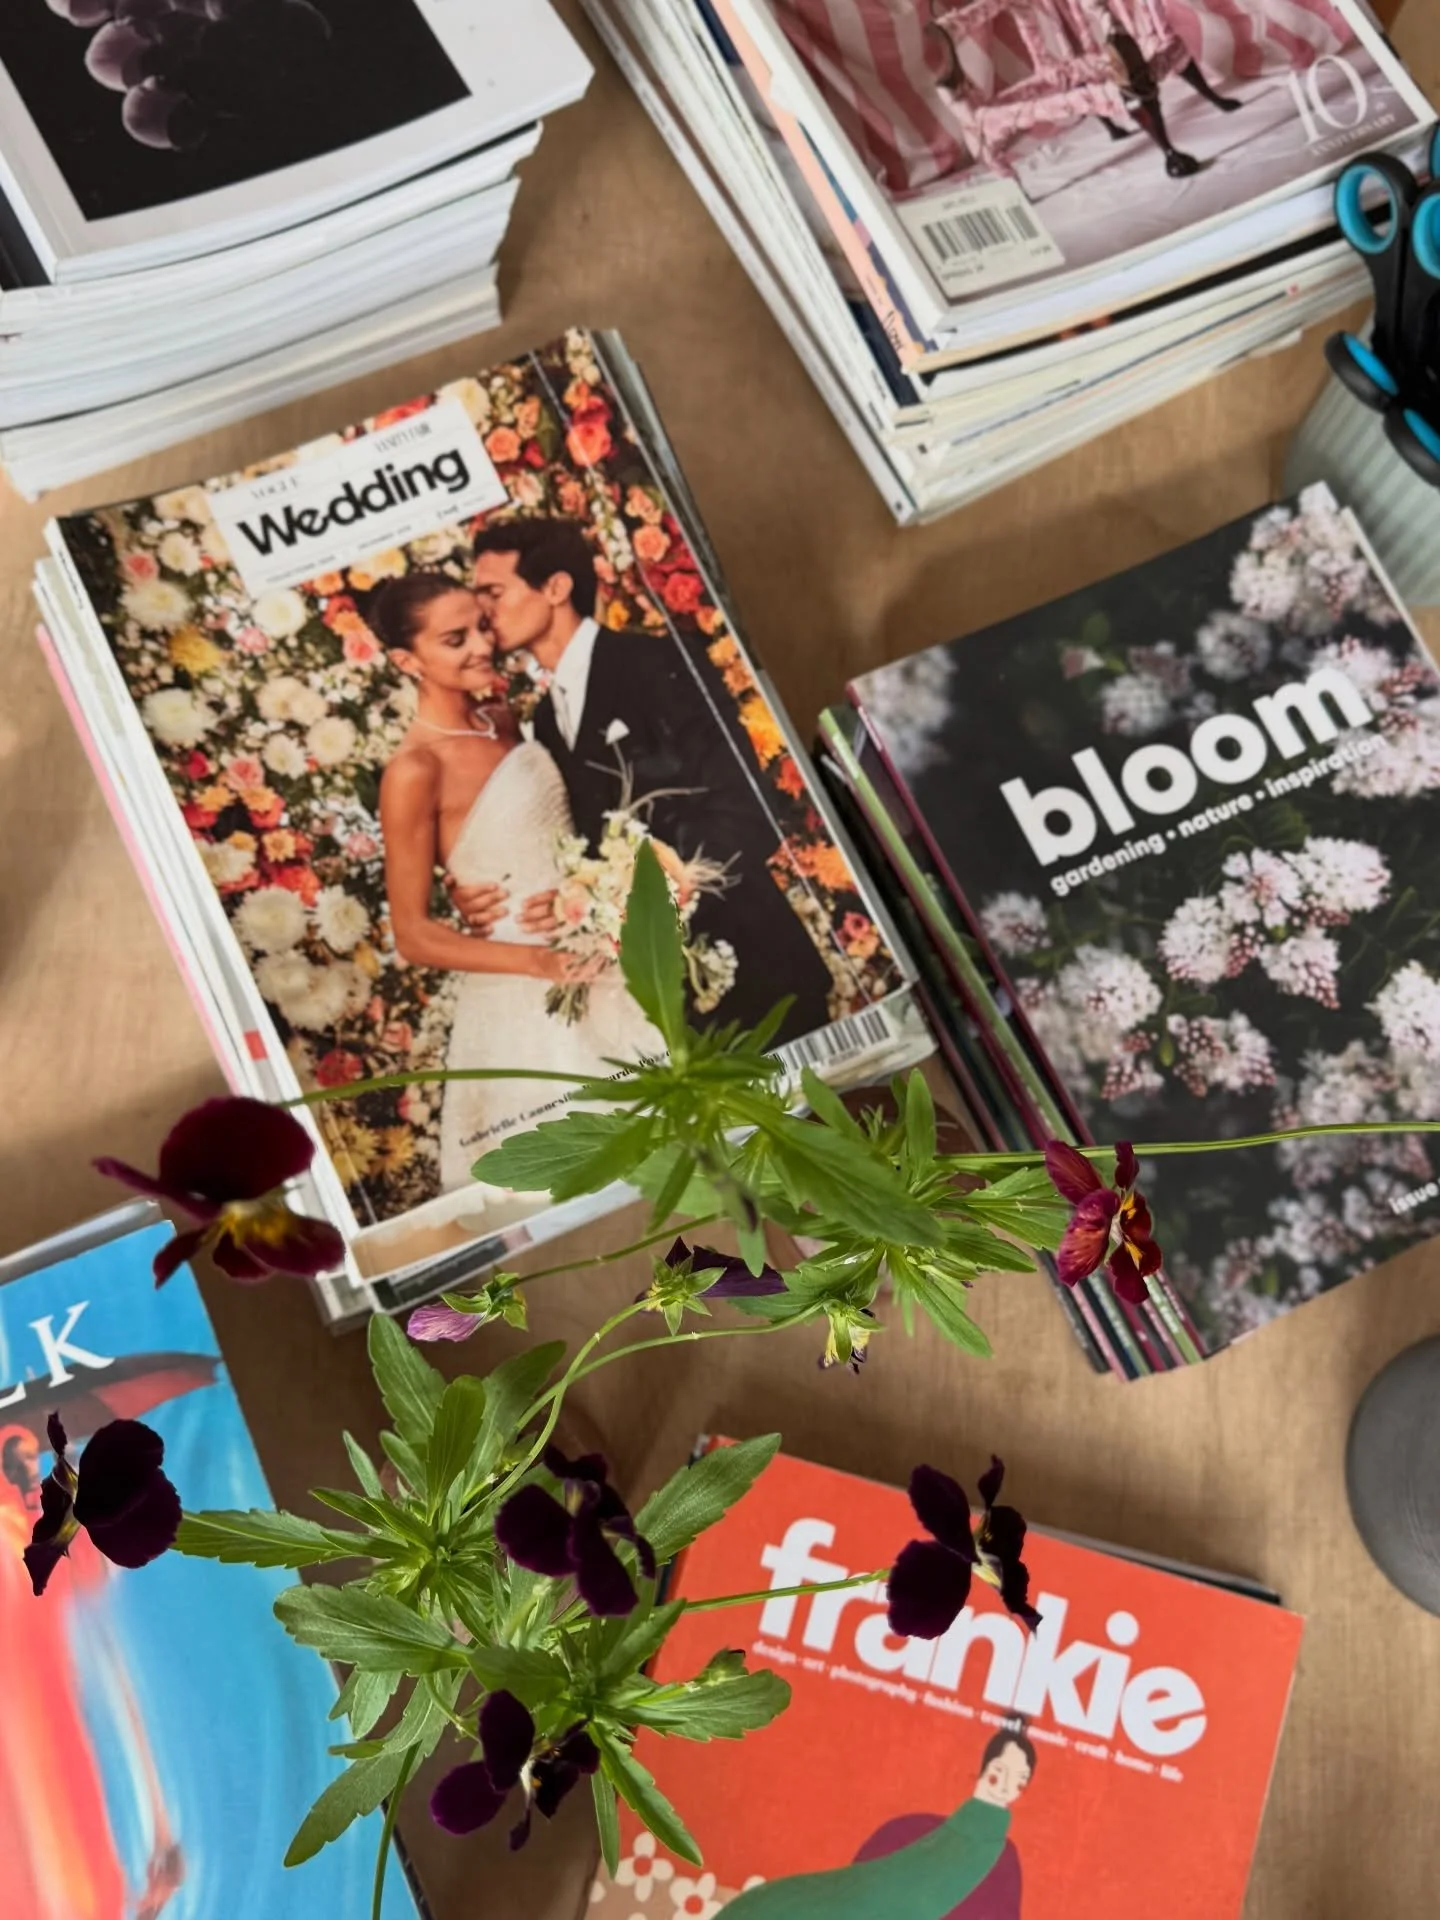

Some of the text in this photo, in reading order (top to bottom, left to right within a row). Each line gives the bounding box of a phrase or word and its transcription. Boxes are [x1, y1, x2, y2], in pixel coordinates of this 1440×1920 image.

[1287, 54, 1368, 143] 10
[236, 448, 471, 557] Wedding
[999, 667, 1374, 867] bloom
[1049, 733, 1388, 897] gardening nature inspiration
[757, 1517, 1207, 1757] frankie
[829, 1664, 918, 1704] photography
